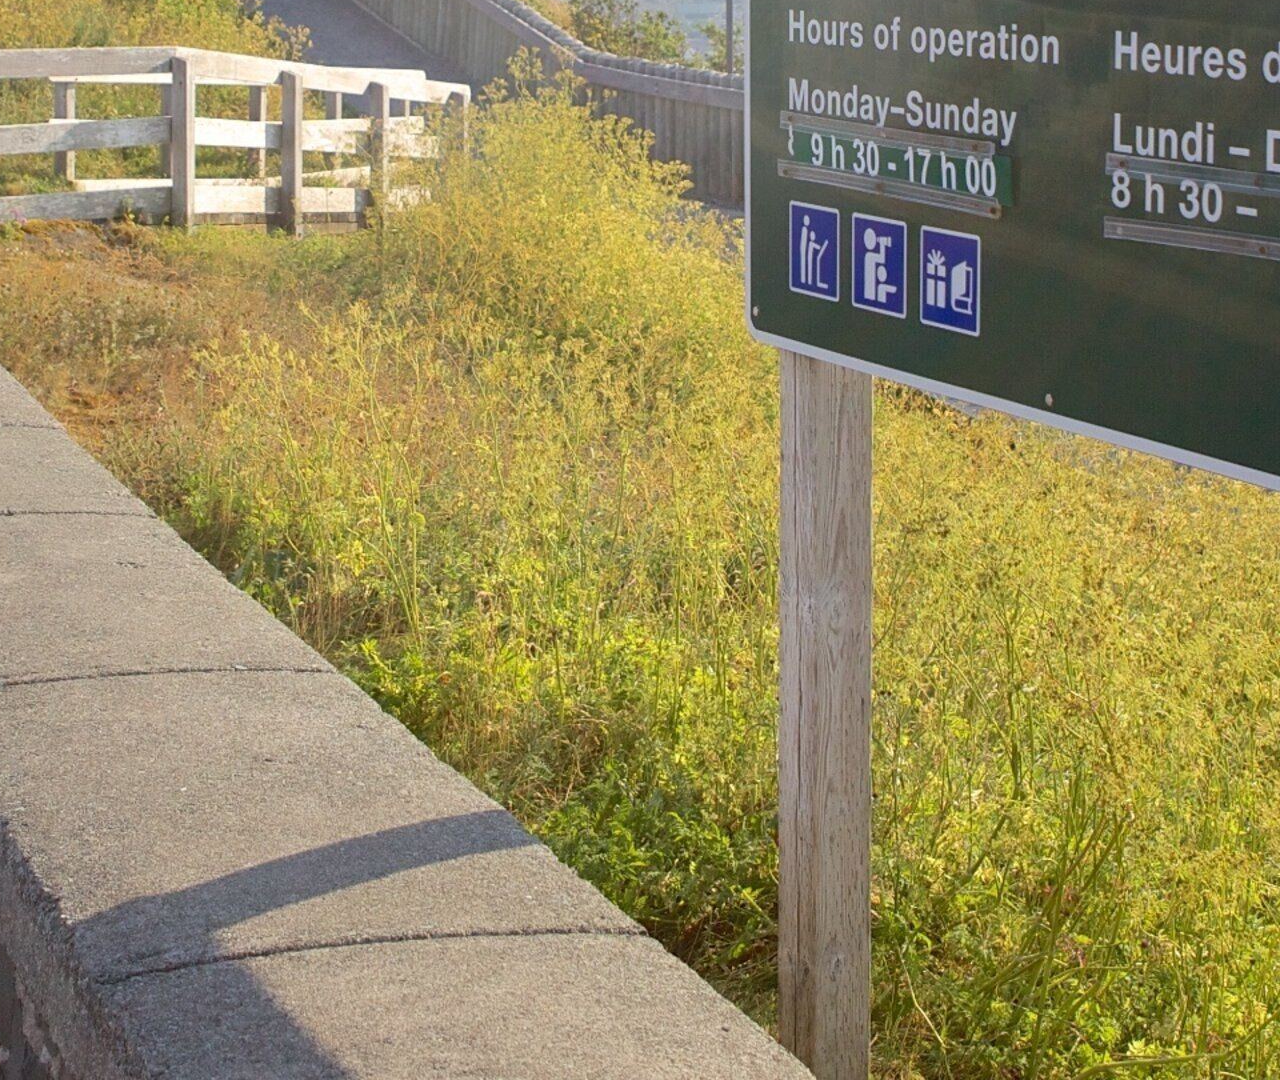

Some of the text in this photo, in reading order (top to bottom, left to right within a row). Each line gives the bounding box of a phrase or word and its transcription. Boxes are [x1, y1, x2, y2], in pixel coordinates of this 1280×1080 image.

[788, 9, 1060, 64] Hours of operation
[1114, 30, 1247, 80] Heures
[1113, 113, 1215, 164] Lundi
[811, 133, 824, 166] 9
[831, 135, 845, 170] h
[853, 137, 880, 177] 30
[904, 146, 931, 185] 17
[940, 151, 957, 190] h
[965, 155, 997, 197] 00
[1111, 170, 1131, 208] 8
[1145, 174, 1165, 214] h
[1179, 178, 1223, 222] 30
